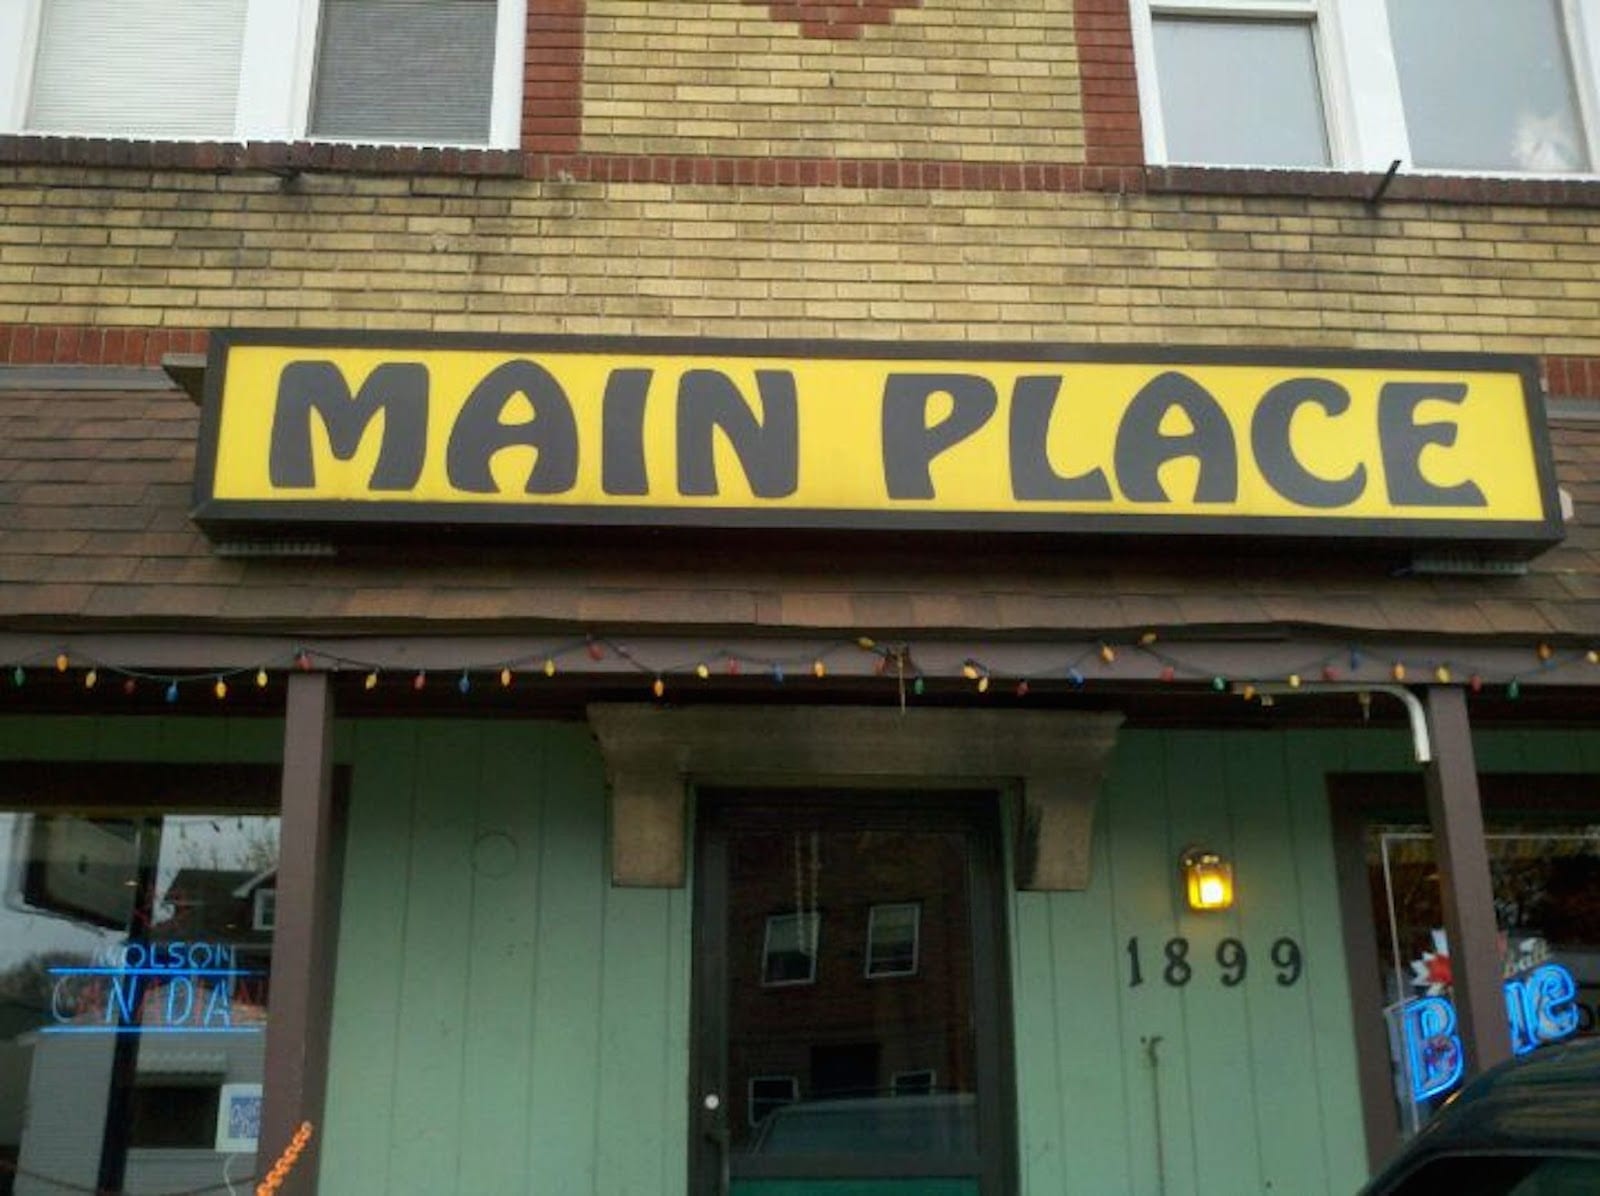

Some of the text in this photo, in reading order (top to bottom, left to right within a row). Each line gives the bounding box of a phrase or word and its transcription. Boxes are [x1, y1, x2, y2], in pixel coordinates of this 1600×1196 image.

[269, 359, 1488, 508] MAIN PLACE
[1127, 936, 1303, 987] 1899
